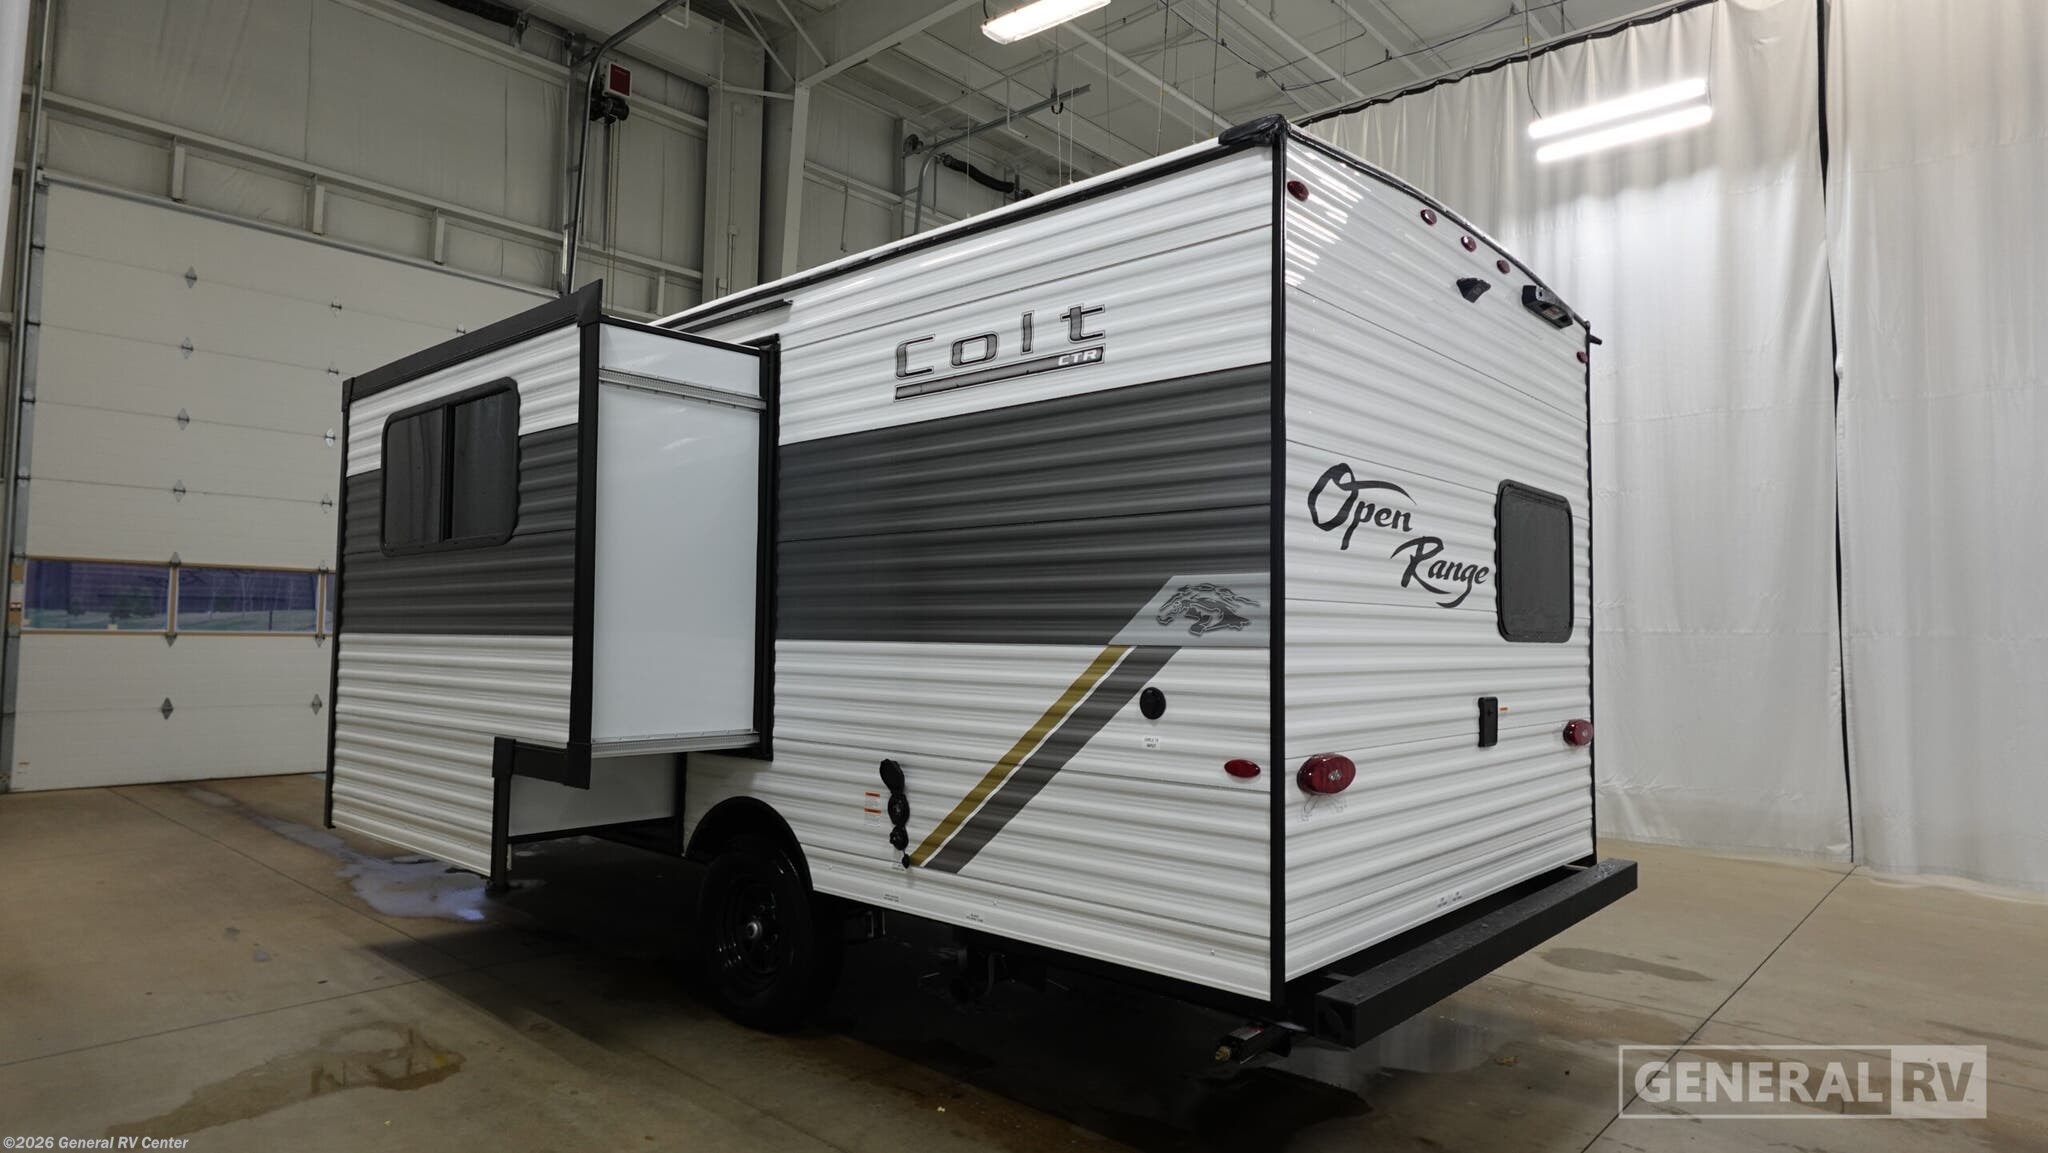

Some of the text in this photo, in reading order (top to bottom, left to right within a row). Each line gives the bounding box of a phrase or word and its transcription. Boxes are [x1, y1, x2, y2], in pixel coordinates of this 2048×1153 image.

[895, 303, 1105, 380] Colt
[1058, 350, 1097, 366] CTR
[1307, 463, 1417, 550] Open
[1390, 536, 1489, 608] Range
